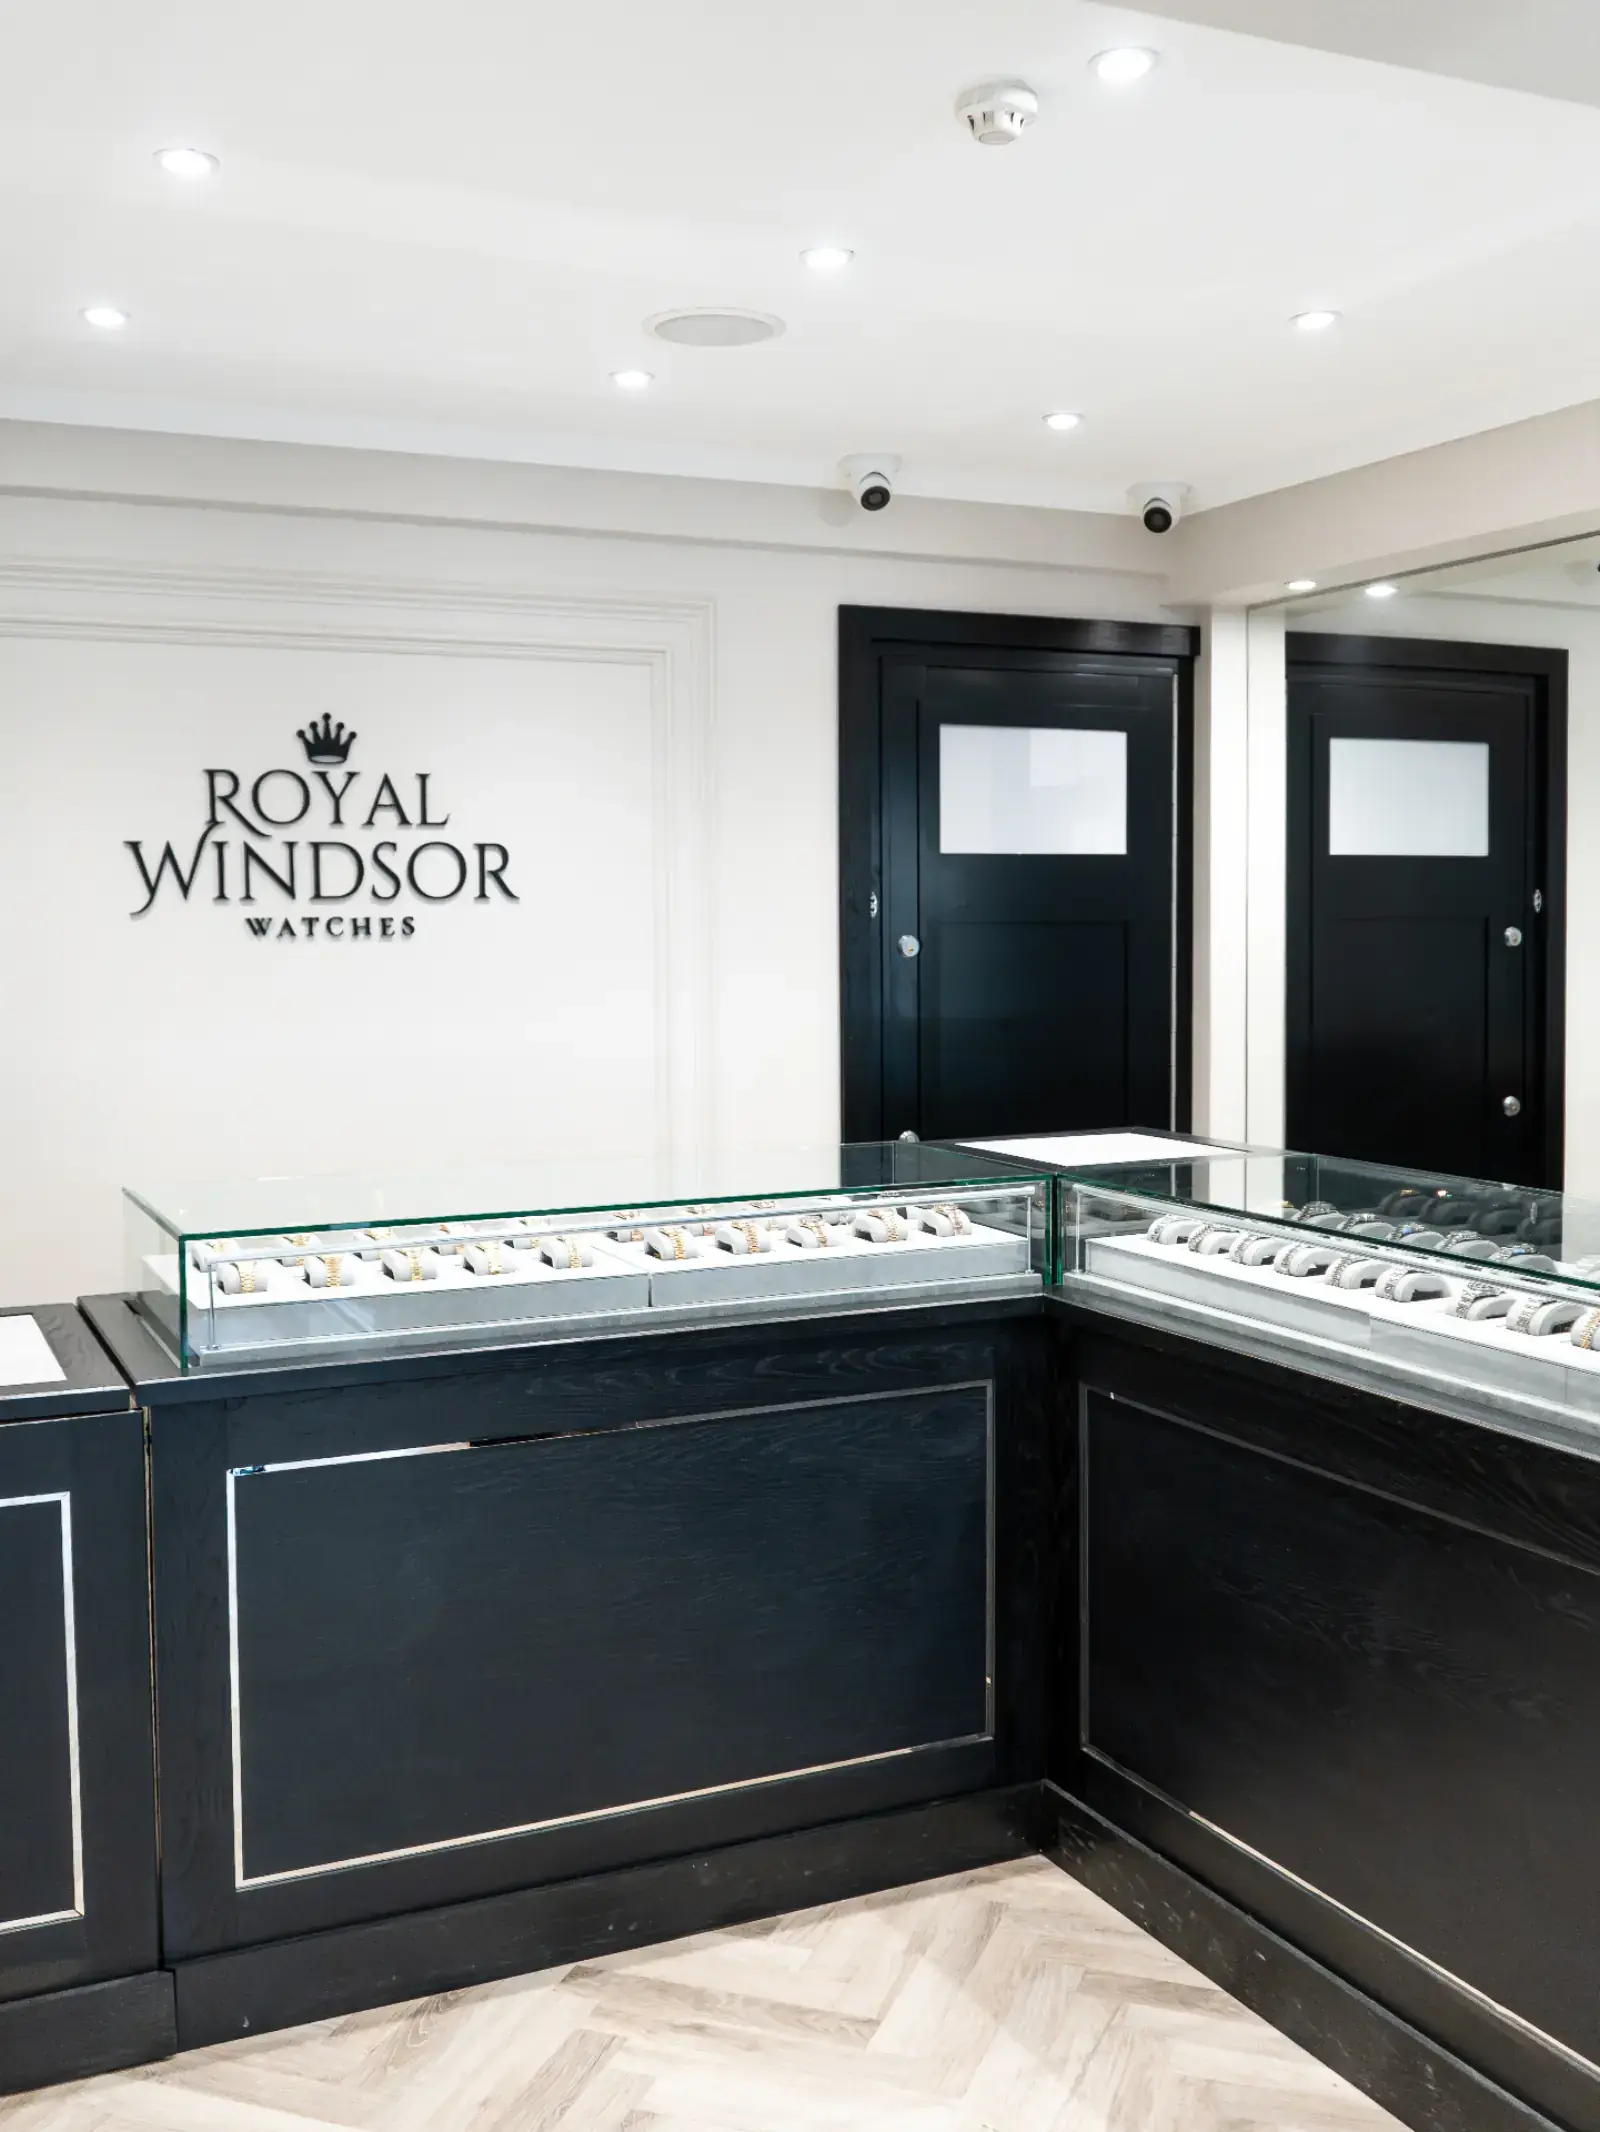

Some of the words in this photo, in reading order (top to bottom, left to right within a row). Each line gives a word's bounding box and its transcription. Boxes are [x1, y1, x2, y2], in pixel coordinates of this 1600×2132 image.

[203, 769, 450, 838] ROYAL
[123, 823, 520, 917] WINDSOR
[245, 916, 416, 938] WATCHES
